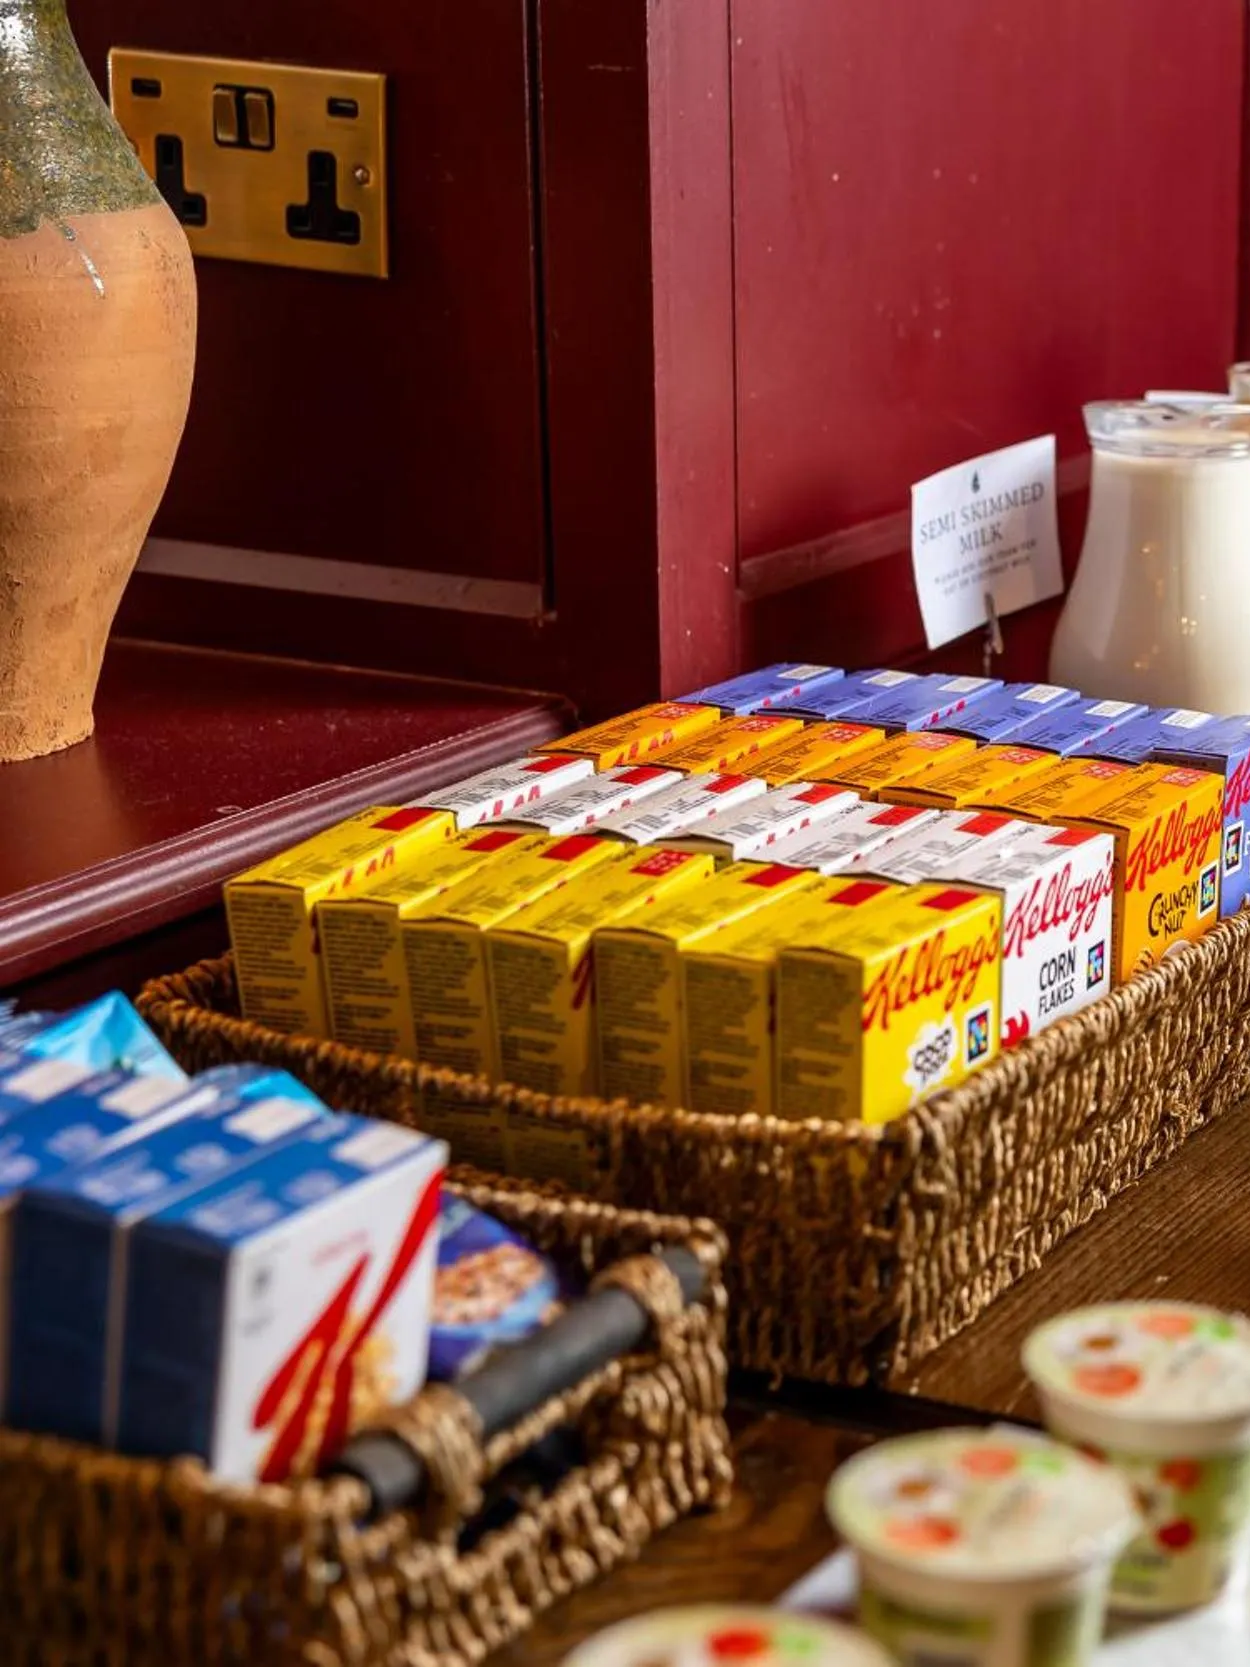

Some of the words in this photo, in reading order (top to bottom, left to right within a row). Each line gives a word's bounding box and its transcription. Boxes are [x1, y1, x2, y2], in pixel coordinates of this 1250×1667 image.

[920, 511, 956, 544] SEMI
[961, 482, 1045, 527] SKIMMED
[959, 523, 1003, 555] MILK
[1124, 788, 1224, 892] Kellogg's
[1003, 849, 1114, 959] Kellogg's
[1165, 909, 1187, 940] NUT
[861, 915, 999, 1032] Kellogg's
[1039, 945, 1076, 990] CORN
[1038, 978, 1075, 1017] FLAKES
